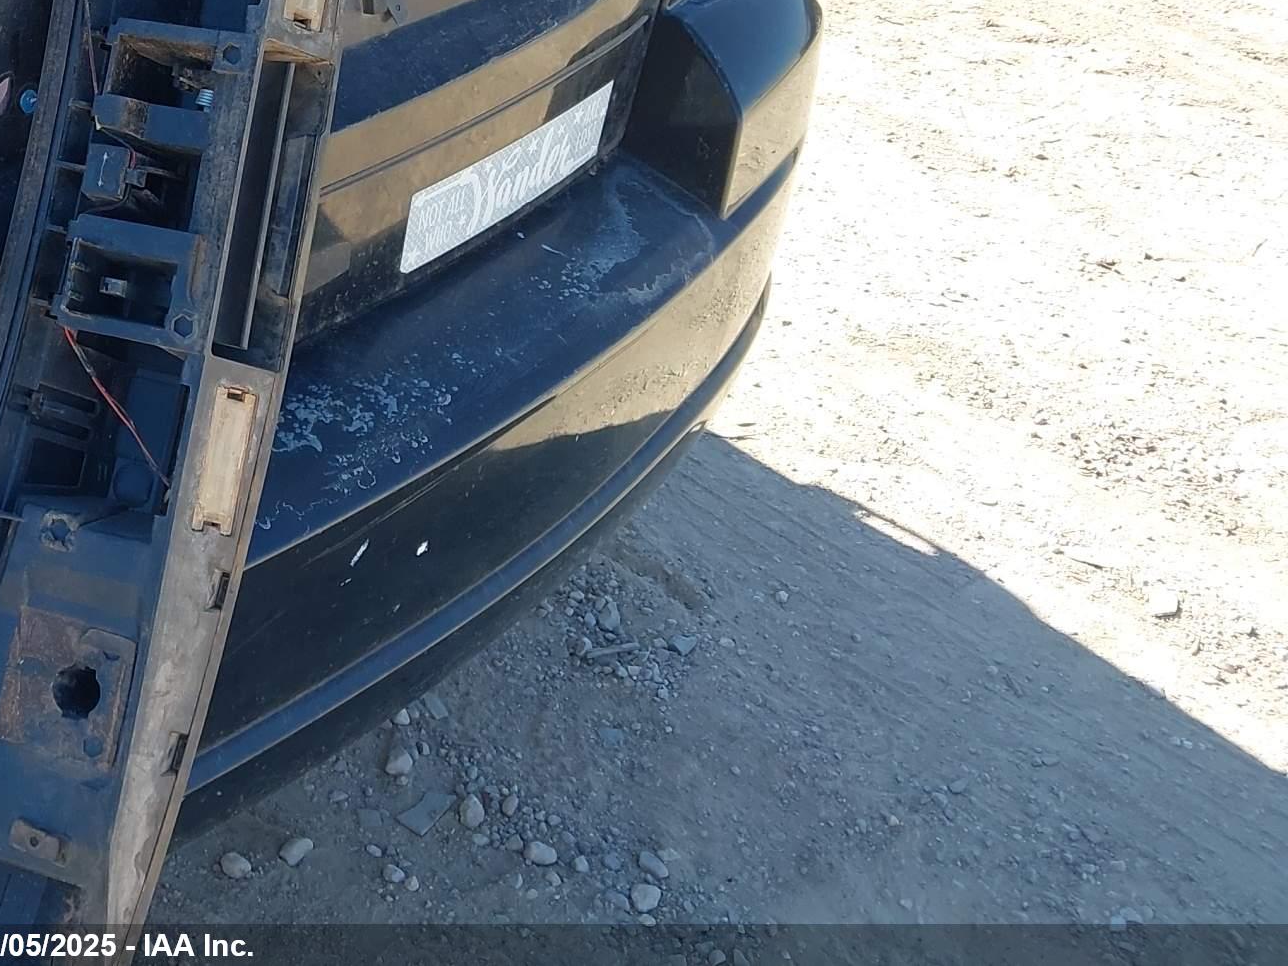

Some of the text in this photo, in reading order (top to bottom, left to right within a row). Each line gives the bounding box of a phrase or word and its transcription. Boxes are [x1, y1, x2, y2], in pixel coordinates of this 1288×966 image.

[418, 185, 467, 234] NOT ALL
[425, 220, 453, 254] WHO
